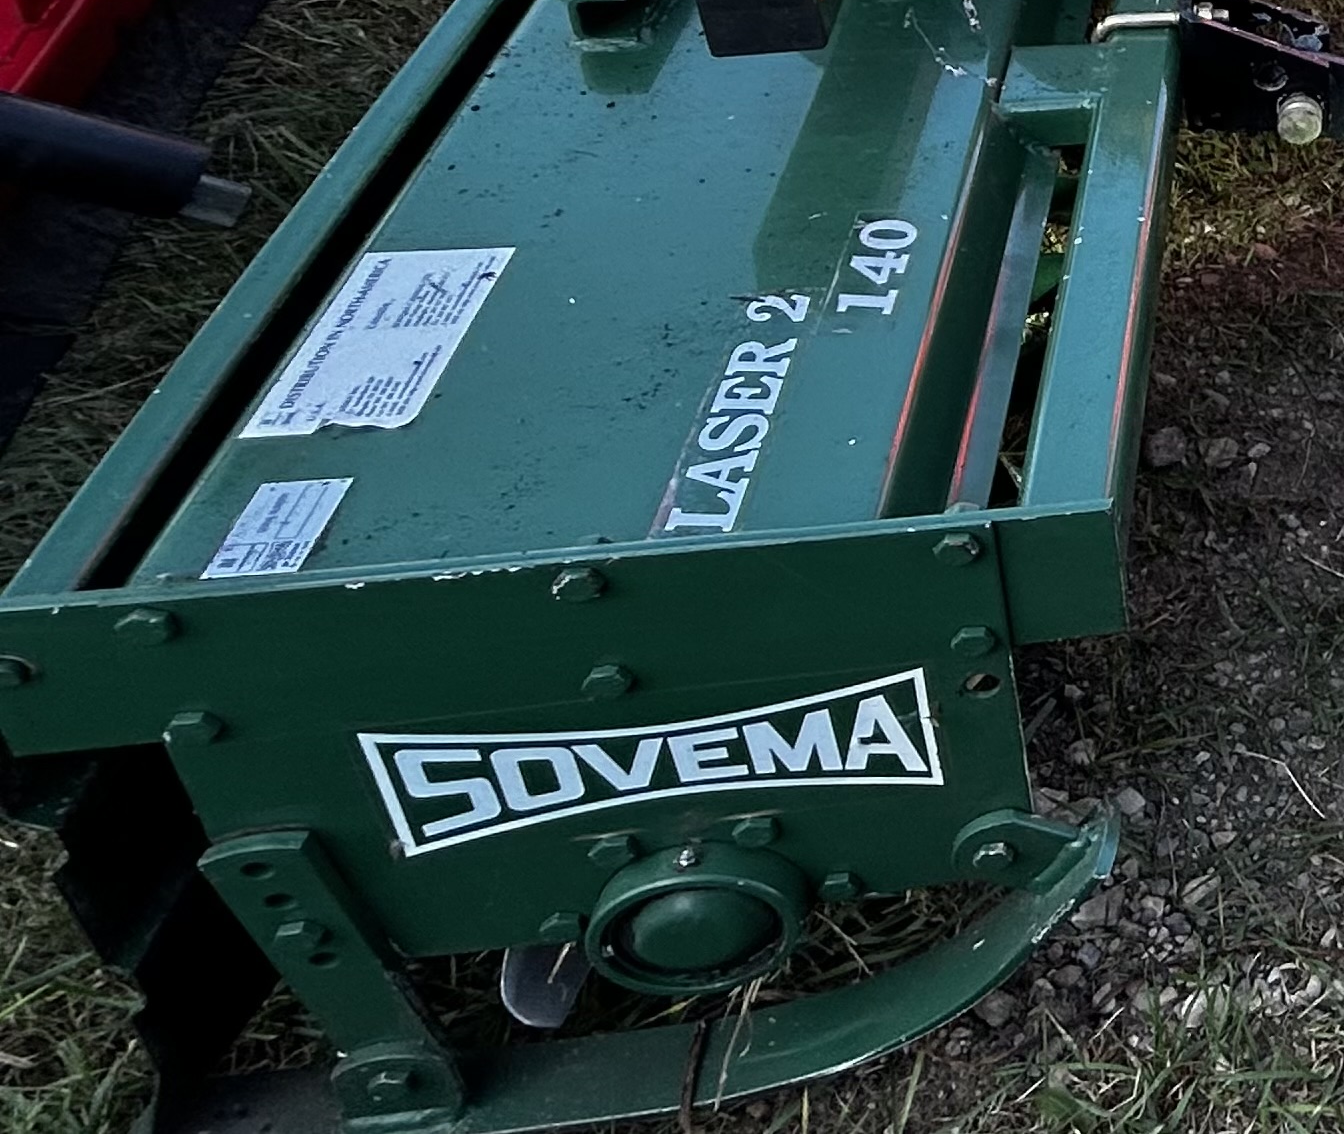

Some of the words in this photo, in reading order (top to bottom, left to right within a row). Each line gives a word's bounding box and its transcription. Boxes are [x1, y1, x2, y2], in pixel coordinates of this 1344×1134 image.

[836, 219, 918, 315] 140
[664, 338, 798, 533] LASER
[746, 293, 811, 323] 2
[394, 694, 928, 837] SOVEMA
